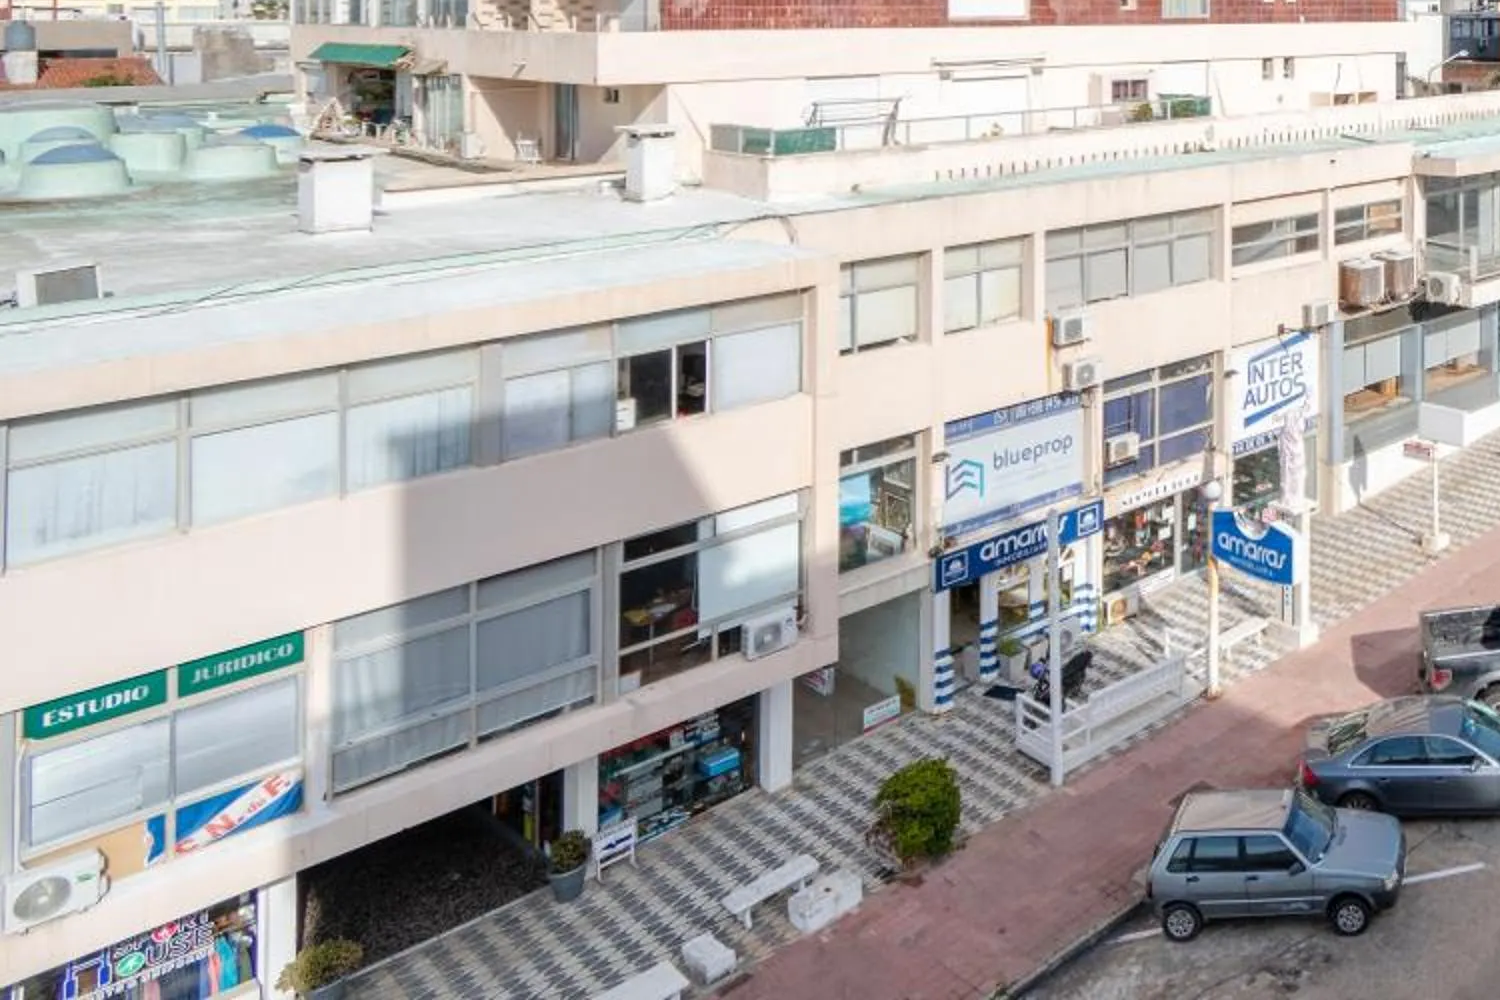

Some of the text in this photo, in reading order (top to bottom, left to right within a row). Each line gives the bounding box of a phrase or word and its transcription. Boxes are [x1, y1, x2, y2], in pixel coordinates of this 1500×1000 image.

[1247, 352, 1303, 385] INTER
[1243, 372, 1306, 410] AUTOS
[993, 434, 1073, 470] blueprop
[979, 515, 1068, 561] amarrs
[1217, 531, 1287, 569] amarras
[42, 642, 294, 728] ESTUDIO JURIDICO
